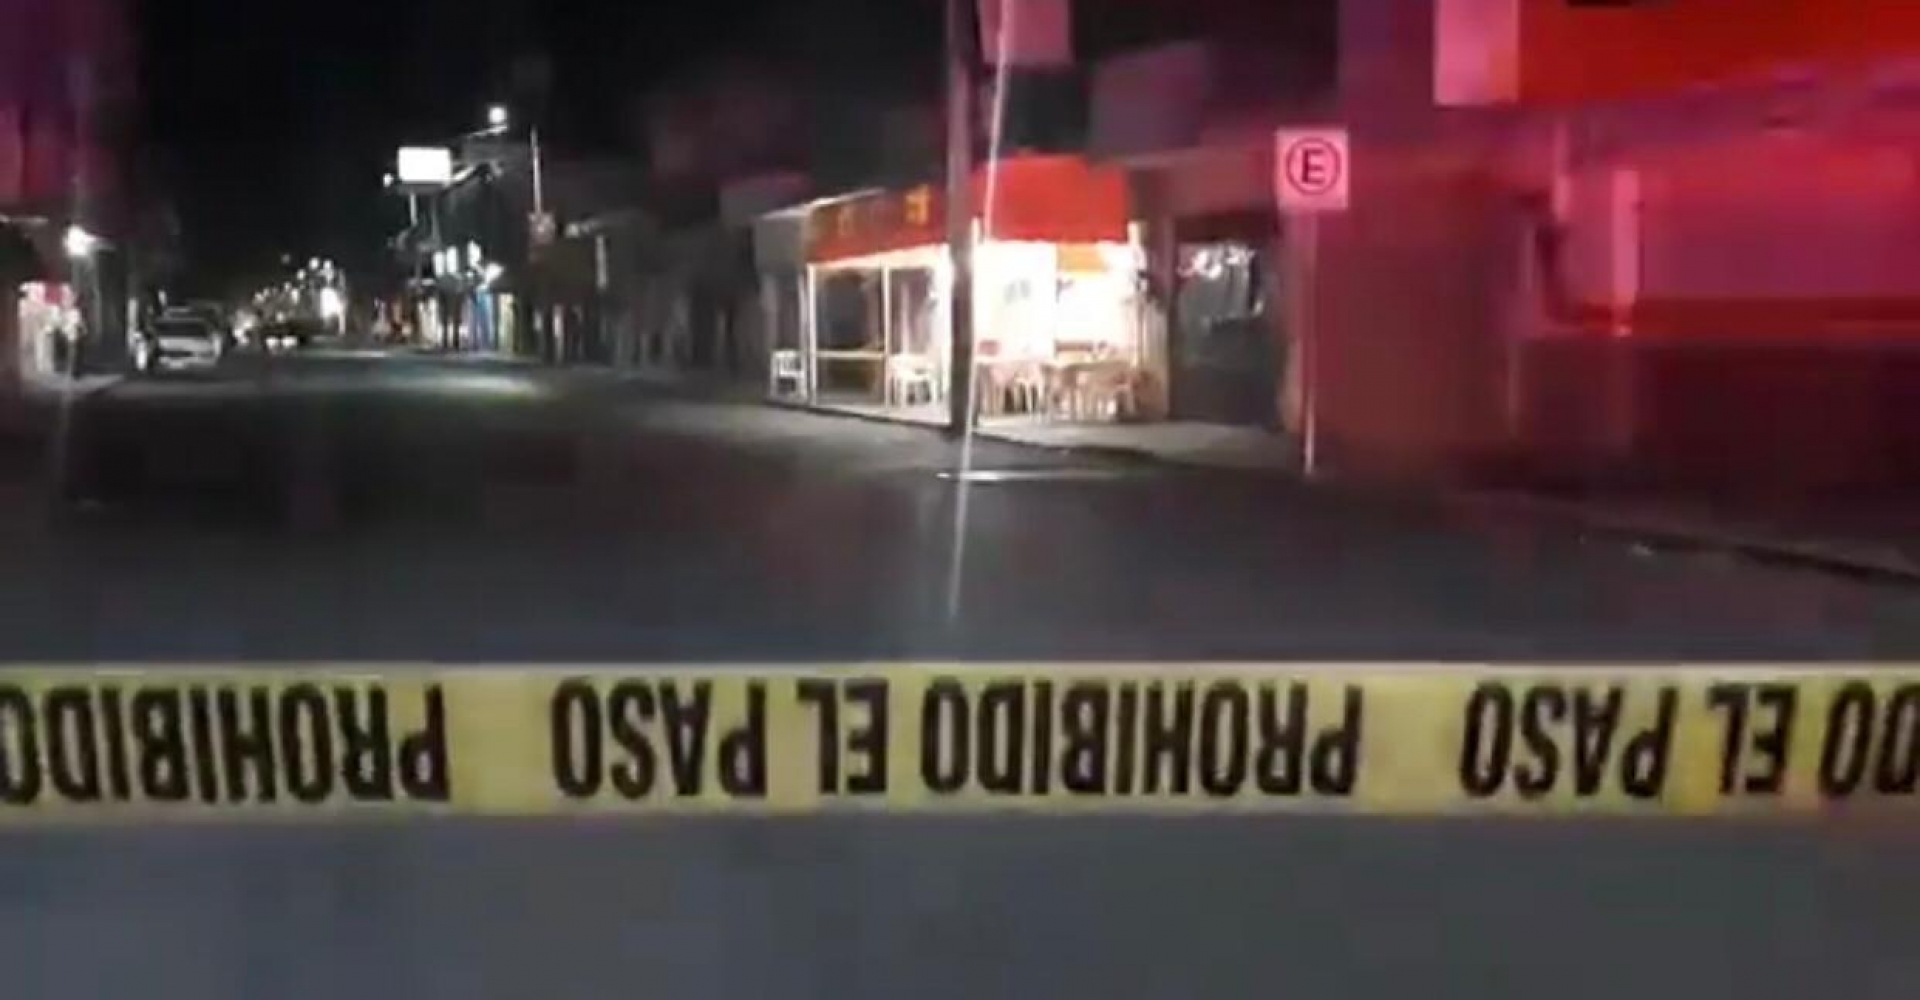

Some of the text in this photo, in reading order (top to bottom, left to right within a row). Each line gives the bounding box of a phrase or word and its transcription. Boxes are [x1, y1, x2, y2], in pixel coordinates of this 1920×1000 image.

[1302, 149, 1325, 184] E
[0, 684, 449, 802] PROHIBIDO
[552, 677, 768, 798] PASO
[798, 678, 887, 793] EL
[920, 677, 1362, 797] PROHIBIDO
[1460, 682, 1680, 797] PASO
[1708, 683, 1797, 794] EL
